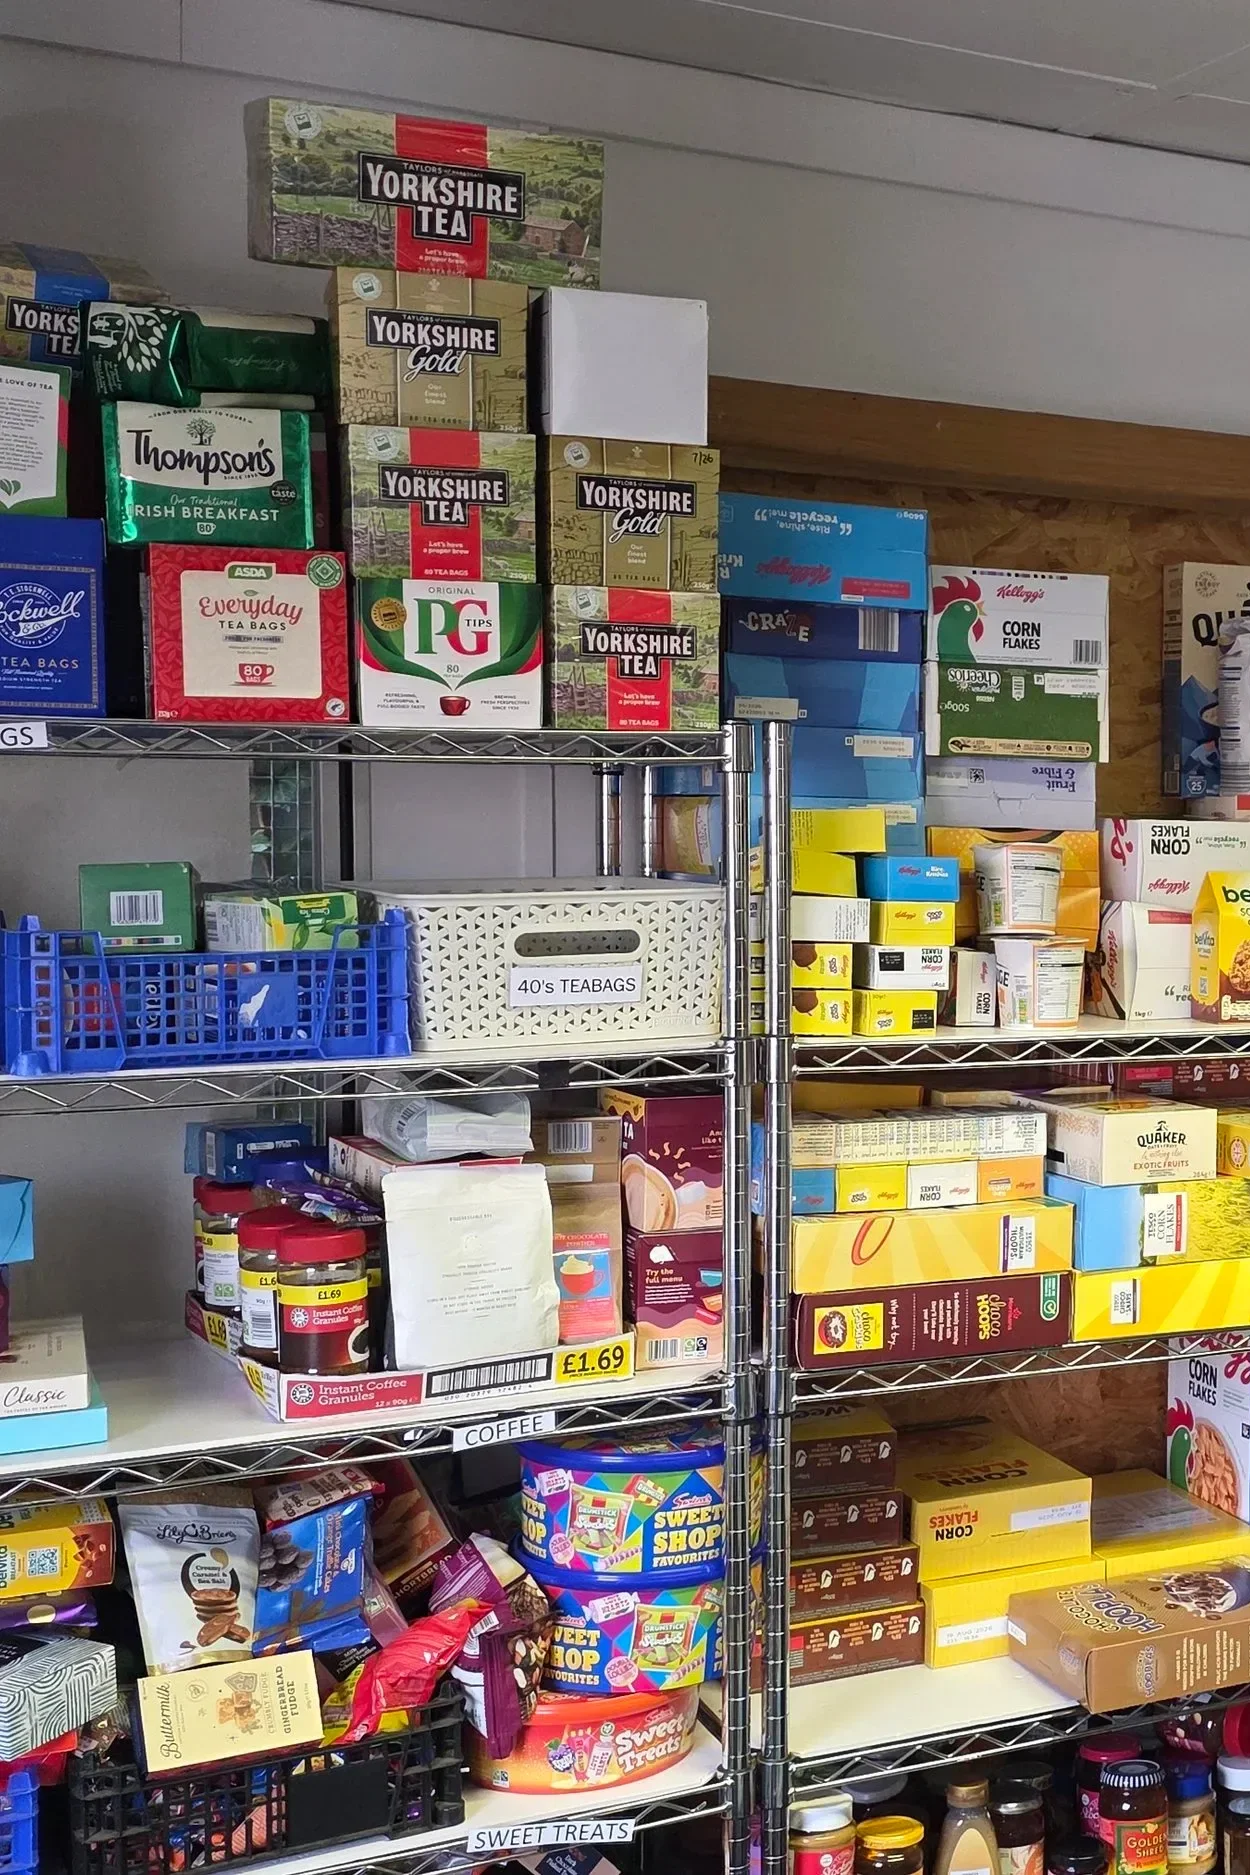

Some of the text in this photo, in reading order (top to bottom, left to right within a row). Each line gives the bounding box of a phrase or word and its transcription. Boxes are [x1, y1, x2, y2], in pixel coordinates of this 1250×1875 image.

[403, 162, 443, 175] TAYLORS
[366, 162, 518, 214] YORKSHIRE
[417, 204, 468, 238] TEA
[373, 315, 497, 351] YORKSHIRE
[403, 345, 467, 383] Gold
[5, 377, 25, 386] LOVE
[126, 429, 277, 486] Thompson's
[271, 488, 297, 499] taste
[385, 470, 504, 503] YORKSHIRE
[583, 481, 693, 513] YORKSHIRE
[131, 504, 280, 523] IRISH BREAKFAST
[425, 501, 465, 523] TEA
[609, 511, 667, 544] Gold
[233, 567, 268, 579] ASDA
[428, 586, 475, 595] ORIGINAL
[996, 585, 1045, 603] Kellogg's
[199, 596, 304, 625] Everyday
[219, 620, 287, 631] TEA BAGS
[414, 599, 493, 656] PG
[465, 619, 492, 628] TIPS
[739, 611, 812, 643] CRAZE
[1002, 621, 1041, 638] CORN
[585, 627, 693, 657] YORKSHIRE
[1002, 638, 1041, 651] FLAKES
[2, 656, 79, 670] TEA BAGS
[243, 664, 263, 676] 80
[948, 668, 1001, 689] Cheerios
[0, 728, 34, 746] GS
[1031, 766, 1062, 779] Fibre
[1046, 780, 1076, 792] Fruit
[1150, 825, 1190, 837] FLAKES
[1150, 839, 1191, 855] CORN
[1147, 878, 1191, 894] Kellogg's
[921, 954, 943, 964] CORN
[517, 977, 637, 994] 40's TEABAGS
[1136, 1131, 1187, 1148] QUAKER
[1133, 1160, 1189, 1170] EXOTIC FRUITS
[645, 1268, 674, 1279] Try the
[645, 1275, 683, 1284] full menu
[317, 1289, 342, 1300] £1.69
[312, 1308, 343, 1318] Instant
[312, 1315, 349, 1326] Granules
[976, 1294, 990, 1340] HOOPS
[562, 1344, 625, 1376] £1.69
[1188, 1358, 1218, 1389] CORN
[318, 1379, 408, 1395] Instant Coffee
[1188, 1383, 1217, 1406] FLAKES
[3, 1385, 67, 1408] Classic
[318, 1393, 375, 1406] Granules
[465, 1415, 544, 1447] COFFEE
[653, 1508, 724, 1529] SWEET
[928, 1509, 979, 1528] FLAKES
[652, 1527, 722, 1554] SHOP
[934, 1524, 974, 1542] CORN
[652, 1548, 720, 1568] FAVOURITES
[192, 1571, 220, 1579] Caramel
[274, 1664, 292, 1735] GINGERBREAD
[289, 1679, 300, 1717] FUDGE
[159, 1680, 183, 1761] Buttermilk
[614, 1722, 684, 1751] Sweet
[619, 1736, 682, 1773] Treats
[474, 1822, 629, 1849] SWEET TREATS
